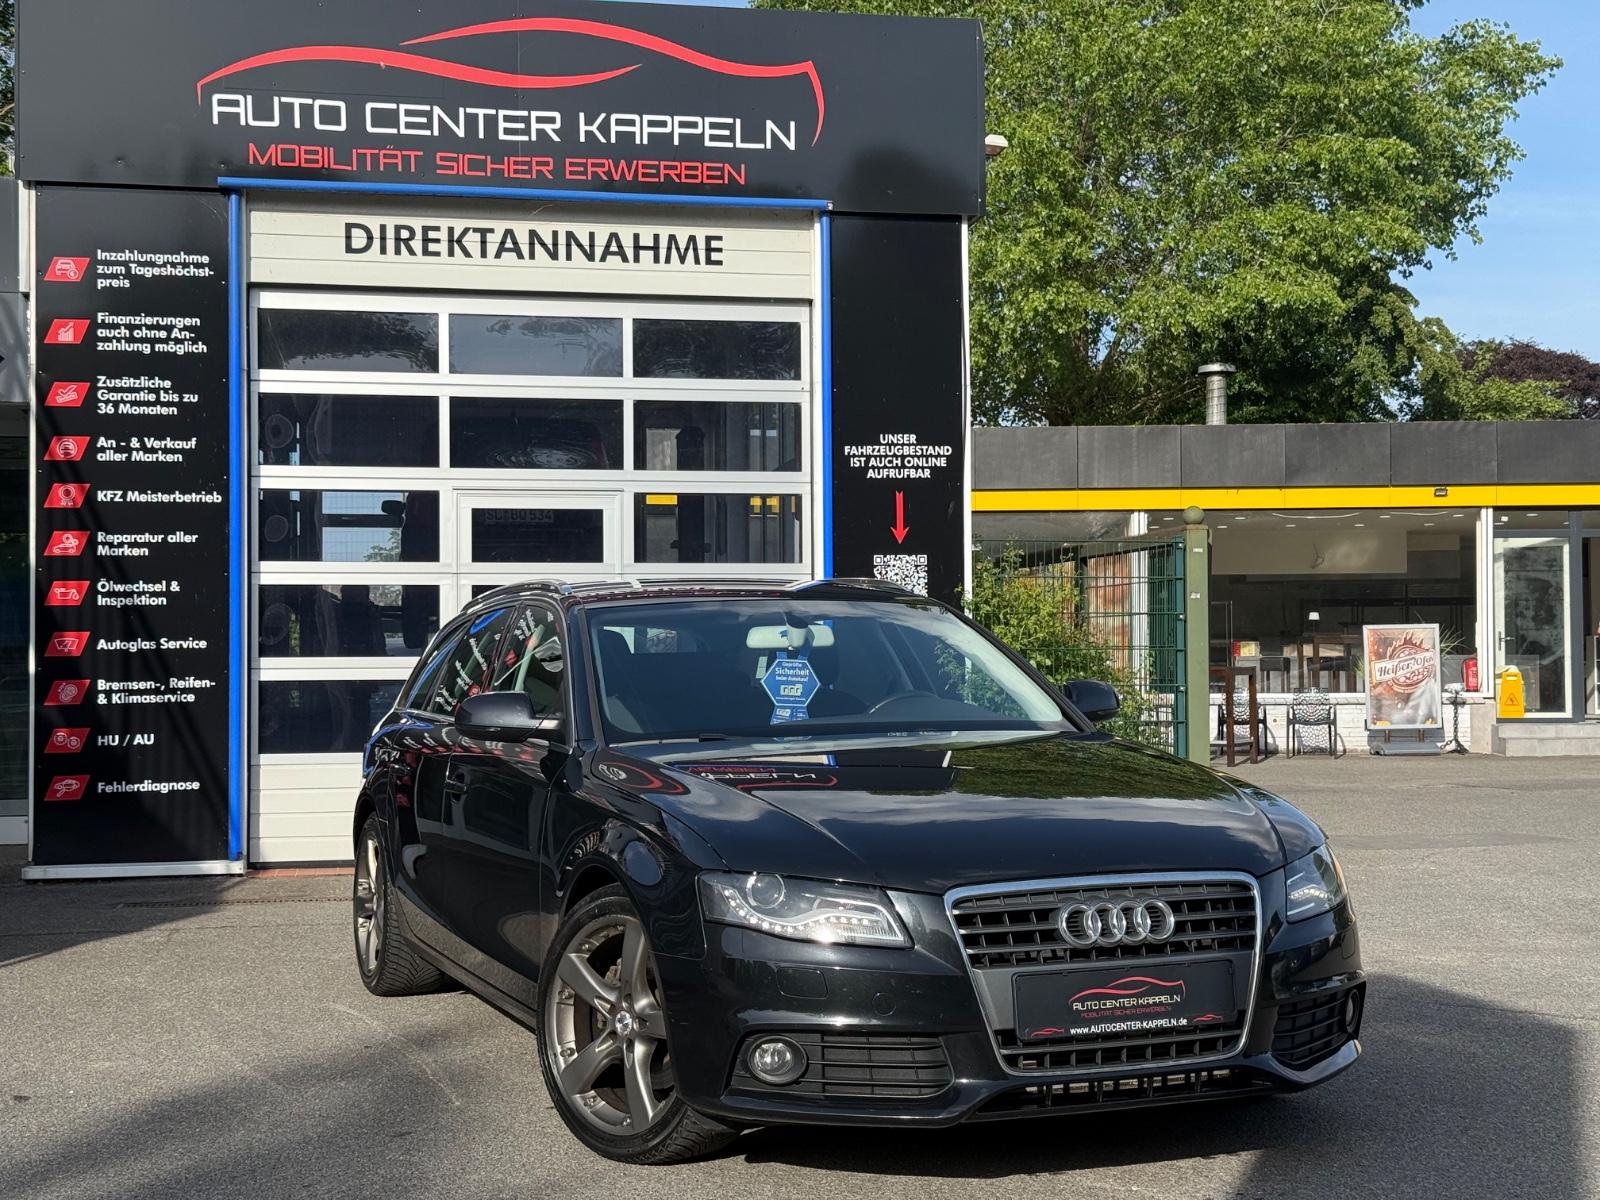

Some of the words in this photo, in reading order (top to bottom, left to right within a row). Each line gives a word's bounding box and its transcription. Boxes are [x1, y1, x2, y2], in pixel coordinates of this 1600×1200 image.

[211, 93, 348, 131] AUTO
[365, 102, 562, 143] CENTER
[578, 111, 796, 152] KAPPELN
[247, 142, 424, 175] MOBILITÄT
[435, 152, 555, 180] SICHER
[564, 158, 747, 185] ERWERBEN
[343, 221, 725, 267] DIREKTANNAHME
[97, 249, 210, 265] Inzahlungnahme
[96, 265, 125, 275] zum
[129, 262, 214, 278] Tageshöchst-
[97, 277, 130, 289] preis
[97, 312, 201, 327] Finanzierungen
[96, 327, 129, 338] auch
[133, 327, 167, 339] ohne
[171, 328, 196, 339] An-
[96, 340, 151, 354] zahlung
[154, 341, 208, 355] möglich
[97, 376, 172, 388] Zusätzliche
[97, 389, 157, 402] Garantie
[159, 390, 179, 402] bis
[182, 393, 199, 403] zu
[97, 402, 115, 414] 36
[118, 403, 178, 415] Monaten
[96, 437, 117, 448] An
[130, 437, 141, 448] &
[144, 437, 198, 450] Verkauf
[879, 433, 917, 444] UNSER
[96, 450, 129, 462] aller
[131, 450, 183, 463] Marken
[844, 445, 953, 456] FAHRZEUGBESTAND
[850, 457, 866, 467] IST
[868, 457, 902, 467] AUCH
[904, 457, 947, 467] ONLINE
[866, 468, 931, 479] AUFRUFBAR
[97, 490, 123, 502] KFZ
[126, 490, 223, 503] Meisterbetrieb
[97, 532, 164, 545] Reparatur
[166, 531, 199, 543] aller
[97, 544, 149, 556] Marken
[97, 579, 167, 592] Ölwechsel
[169, 580, 181, 592] &
[97, 593, 167, 608] Inspektion
[97, 638, 157, 652] Autoglas
[159, 637, 208, 649] Service
[775, 668, 809, 676] Sicherheit
[97, 678, 165, 692] Bremsen-,
[169, 677, 216, 688] Reifen-
[97, 693, 107, 704] &
[111, 691, 196, 704] Klimaservice
[97, 735, 119, 746] HU
[123, 735, 130, 747] /
[133, 733, 155, 745] AU
[97, 780, 201, 794] Fehlerdiagnose
[1072, 1000, 1099, 1011] AUTO
[1100, 998, 1137, 1009] CENTER
[1138, 994, 1181, 1005] KAPPELN
[1070, 1017, 1188, 1035] www.AUTOCENTER-KAPPELN.de
